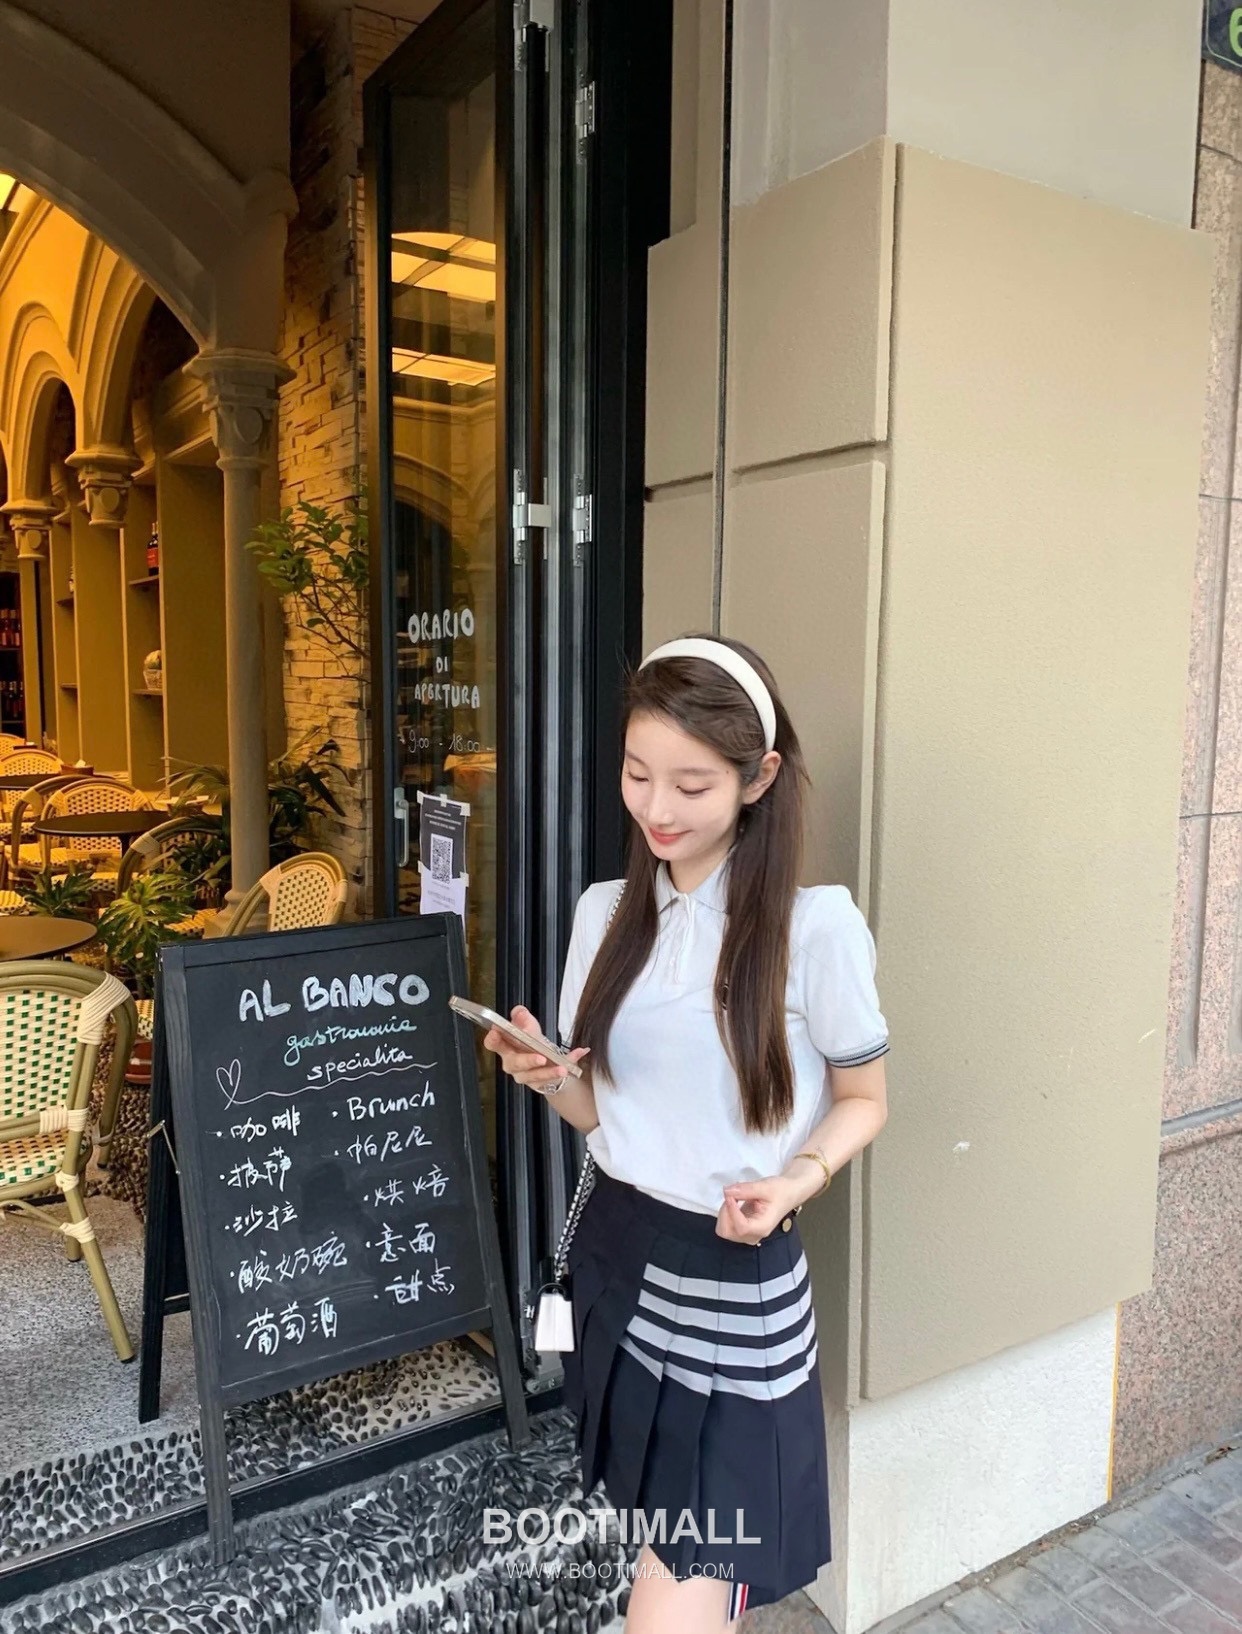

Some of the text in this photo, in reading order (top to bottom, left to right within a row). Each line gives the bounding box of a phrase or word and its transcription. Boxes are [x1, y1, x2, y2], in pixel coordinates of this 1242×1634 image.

[407, 607, 475, 644] ORARIO
[436, 656, 449, 673] DI
[414, 683, 480, 709] APERTURA
[239, 973, 430, 1022] AL BANCO
[347, 1080, 436, 1121] Brunch
[230, 1105, 301, 1142] 咖啡
[346, 1125, 433, 1164] 帕尼尼
[227, 1146, 293, 1192] 披萨
[374, 1163, 450, 1207] 烘焙
[232, 1201, 298, 1237] 沙拉
[237, 1230, 348, 1294] 酸奶碗
[375, 1222, 436, 1263] 意面
[385, 1258, 455, 1305] 甜点
[244, 1297, 339, 1356] 葡萄酒
